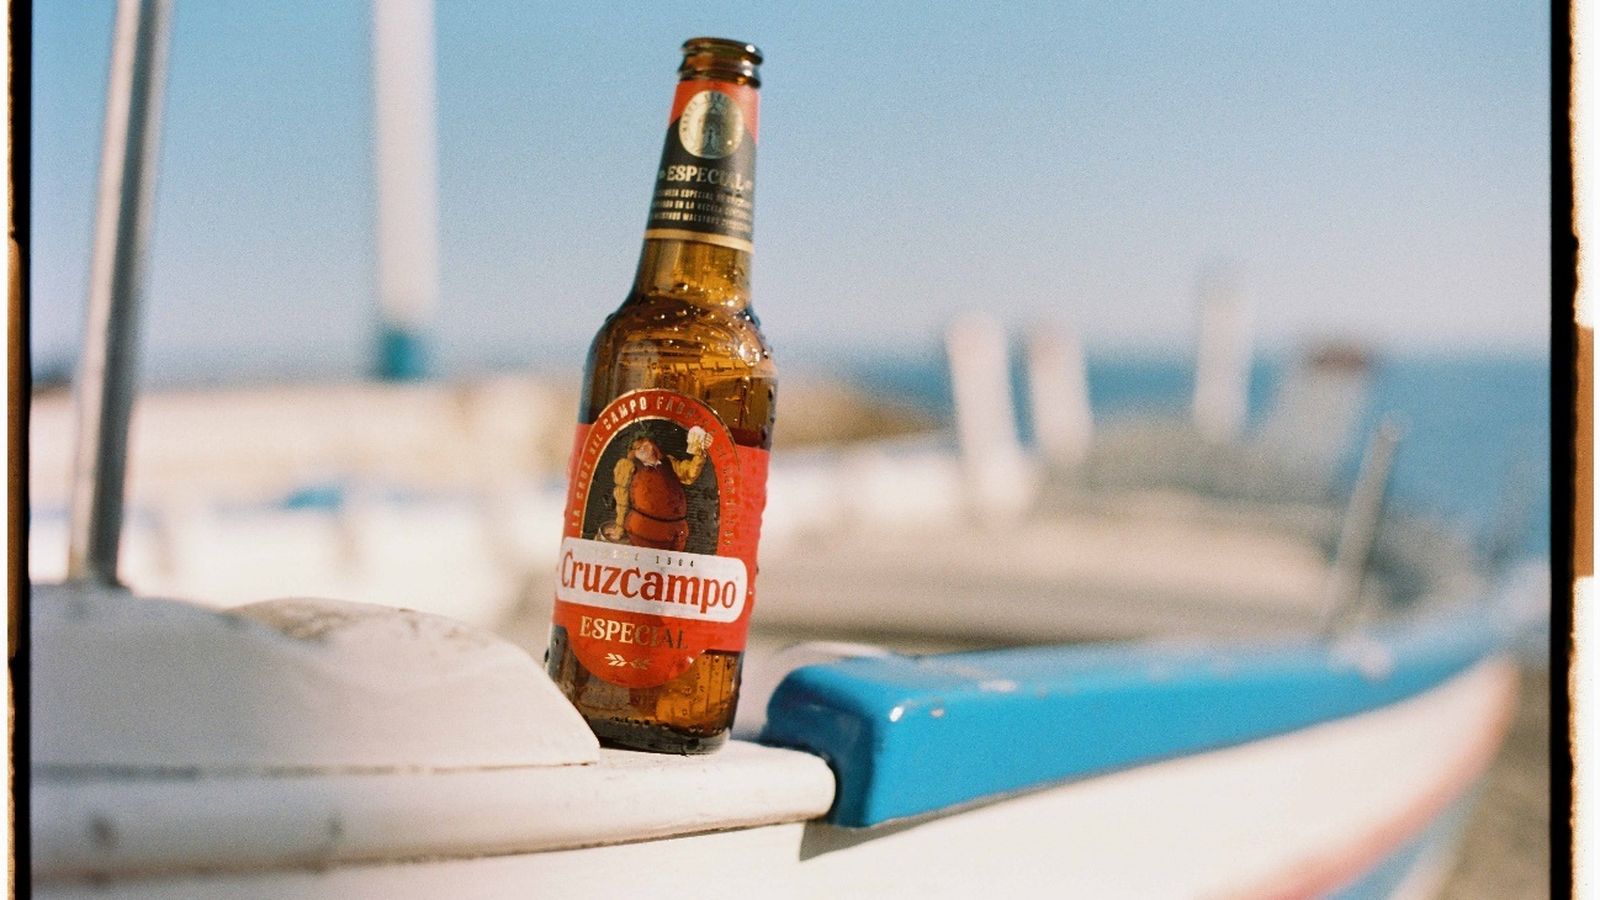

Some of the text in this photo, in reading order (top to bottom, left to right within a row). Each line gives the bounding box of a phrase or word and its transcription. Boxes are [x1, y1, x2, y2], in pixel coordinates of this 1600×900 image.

[576, 461, 592, 500] CRUZ
[602, 396, 648, 431] CAMPO
[560, 549, 738, 615] Cruzcampo
[579, 615, 689, 650] ESPECIAL
